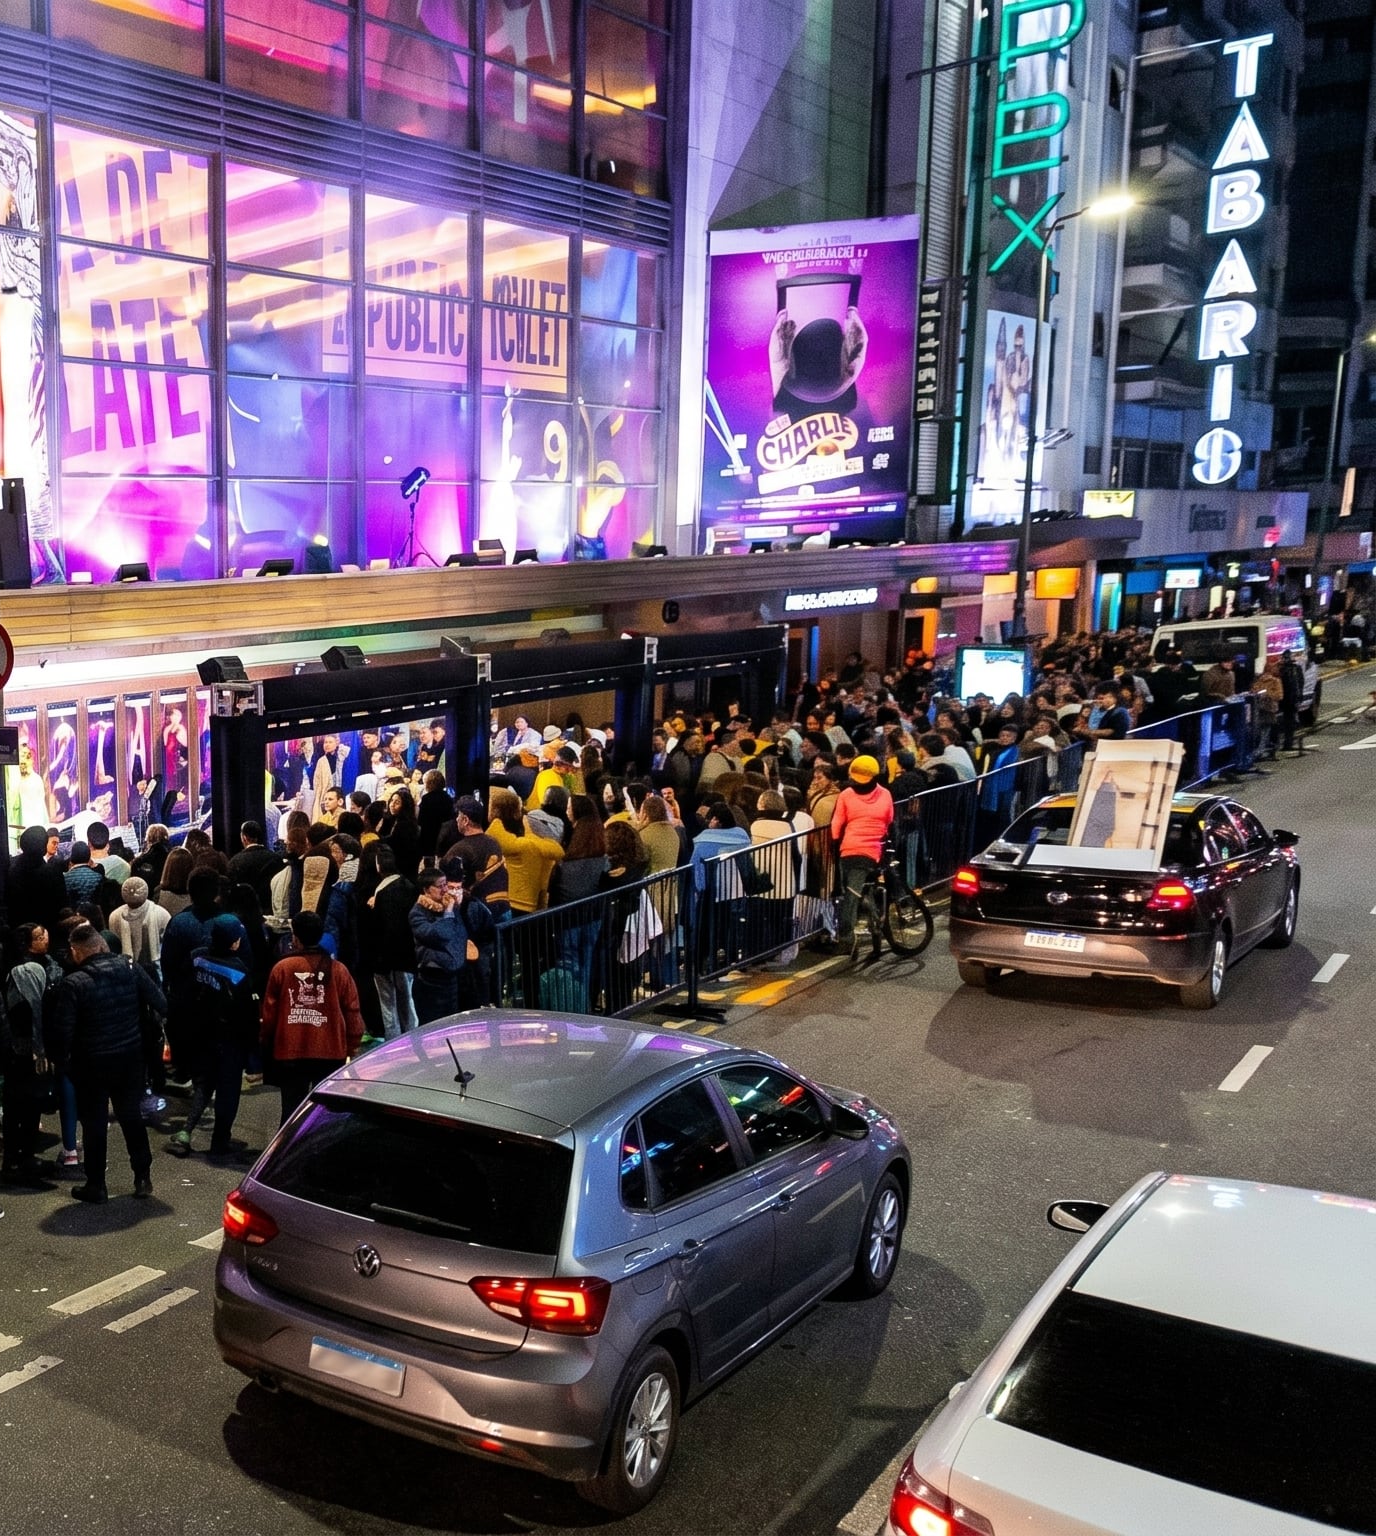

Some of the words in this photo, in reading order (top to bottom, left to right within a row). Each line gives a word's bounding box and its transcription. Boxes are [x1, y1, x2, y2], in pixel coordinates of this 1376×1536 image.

[105, 149, 172, 266] DE
[1192, 32, 1274, 485] TABARIS
[762, 416, 853, 466] CHARLIE
